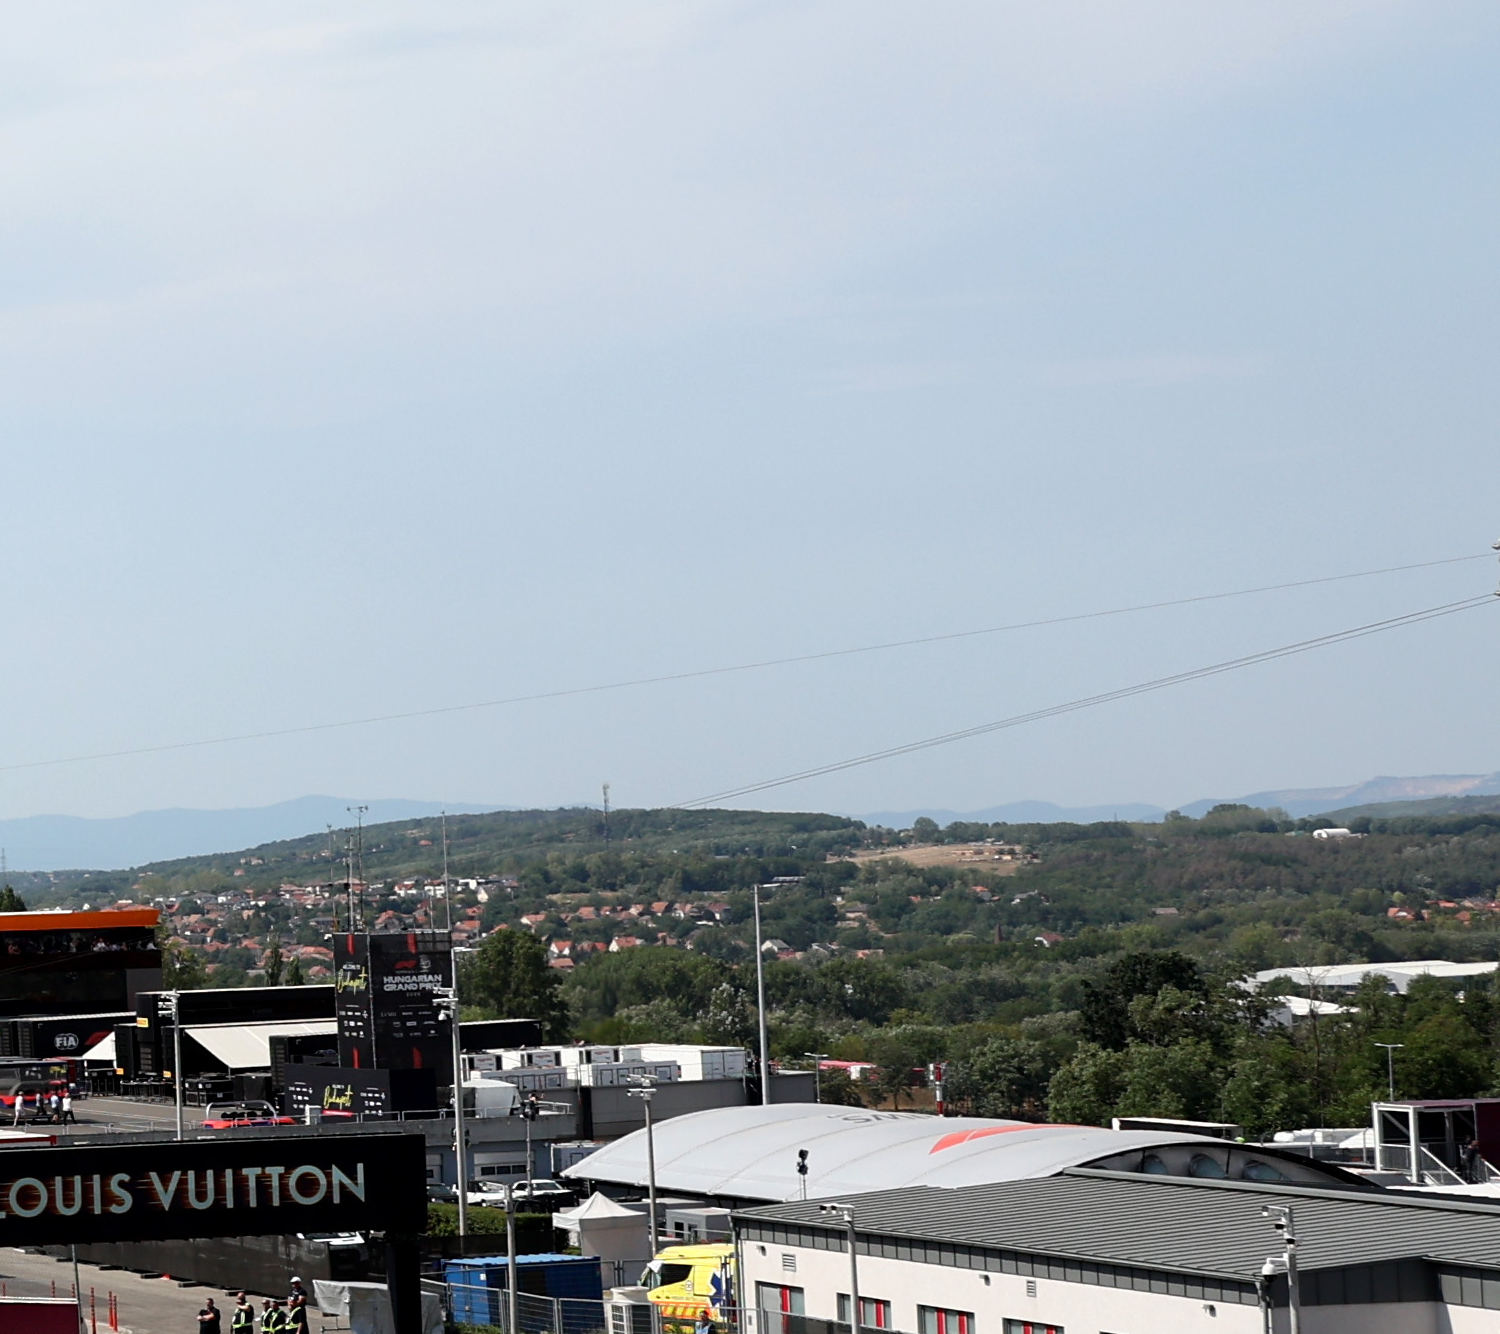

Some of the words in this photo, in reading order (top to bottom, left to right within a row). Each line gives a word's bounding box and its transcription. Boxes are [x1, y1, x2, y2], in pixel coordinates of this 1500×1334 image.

[383, 974, 442, 985] HUNGARIAN
[383, 982, 418, 992] GRAND
[56, 1035, 76, 1048] FIA
[149, 1162, 365, 1211] VUITTON
